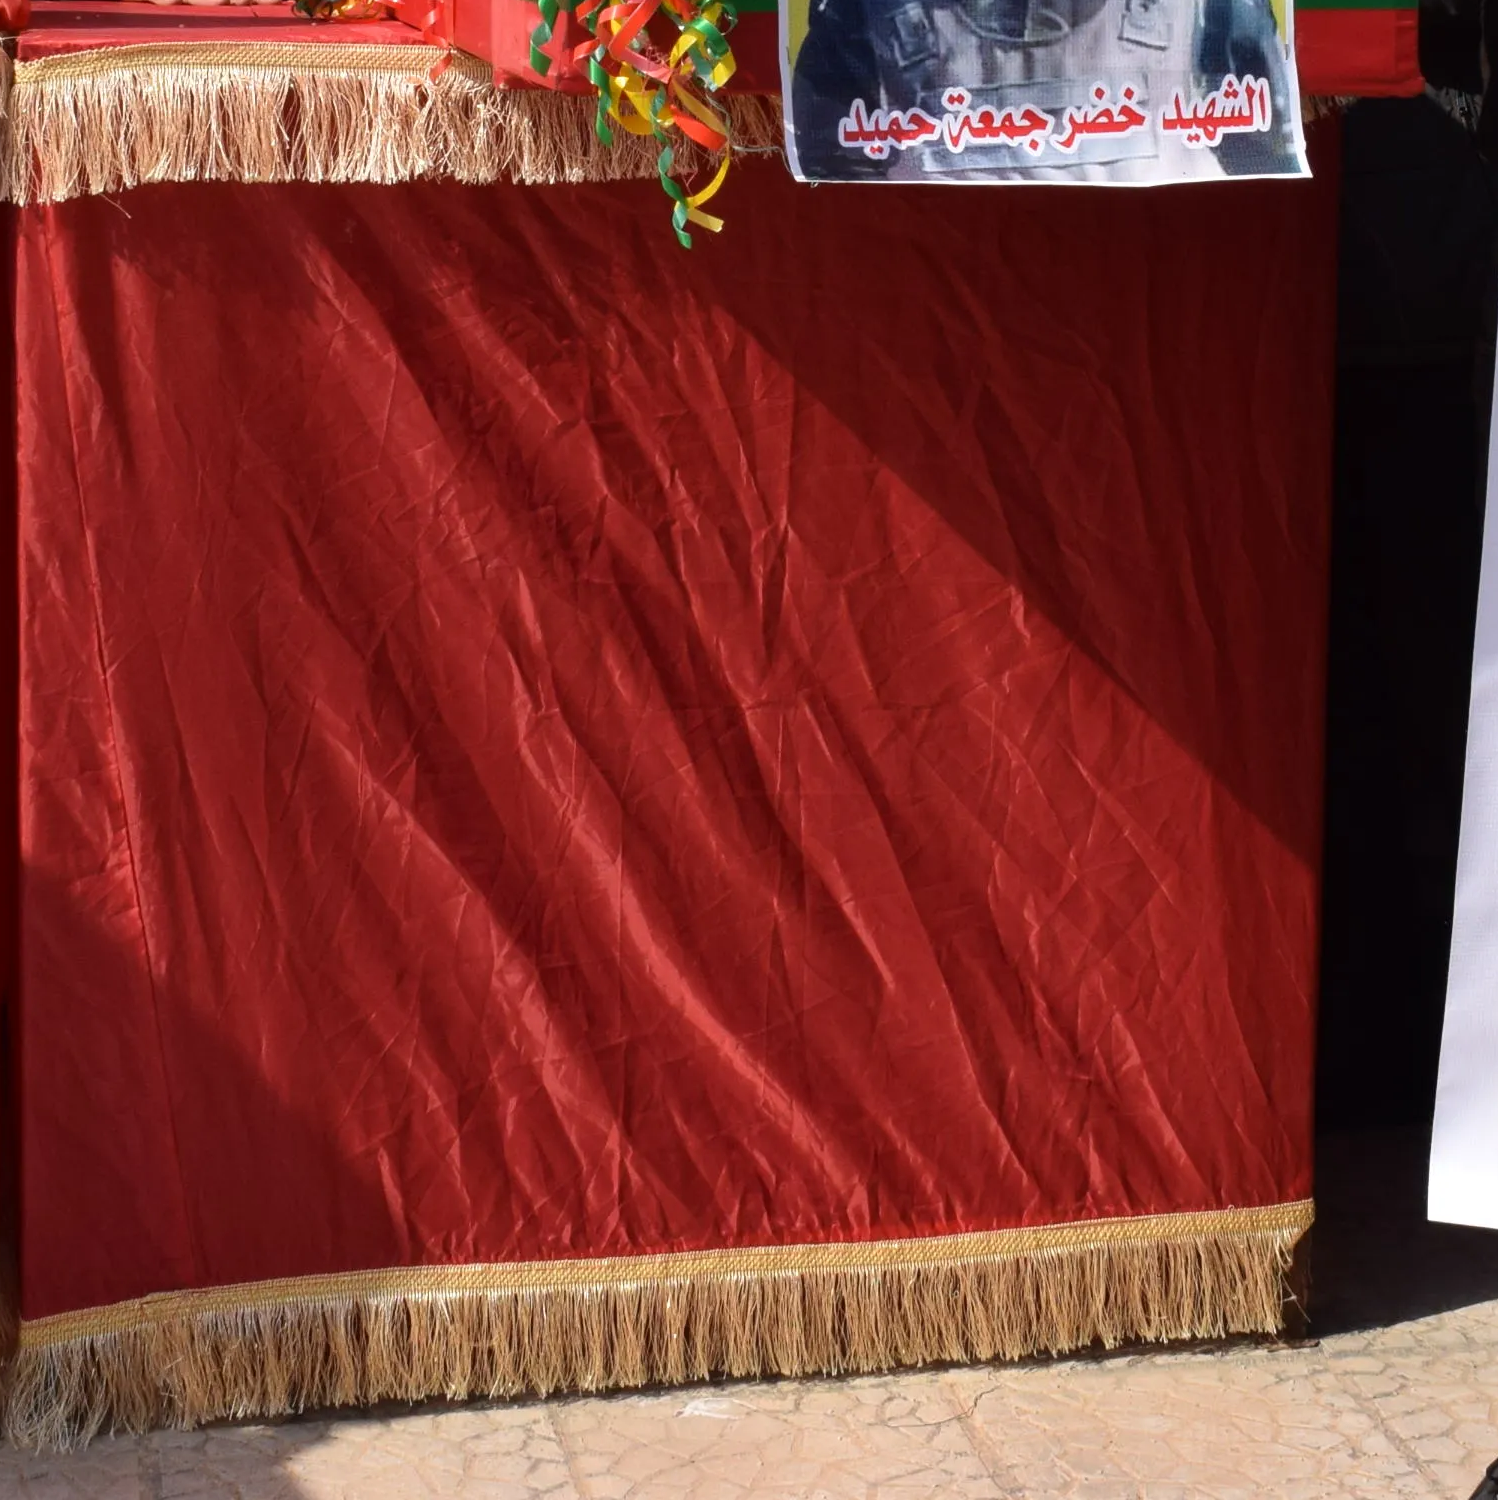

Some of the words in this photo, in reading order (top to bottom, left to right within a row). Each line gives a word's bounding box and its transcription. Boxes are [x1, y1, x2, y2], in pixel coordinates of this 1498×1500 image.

[841, 100, 938, 157] حميد
[944, 89, 1050, 153] جمعة
[1053, 86, 1146, 149] خضر
[1161, 77, 1269, 145] الشهيد
